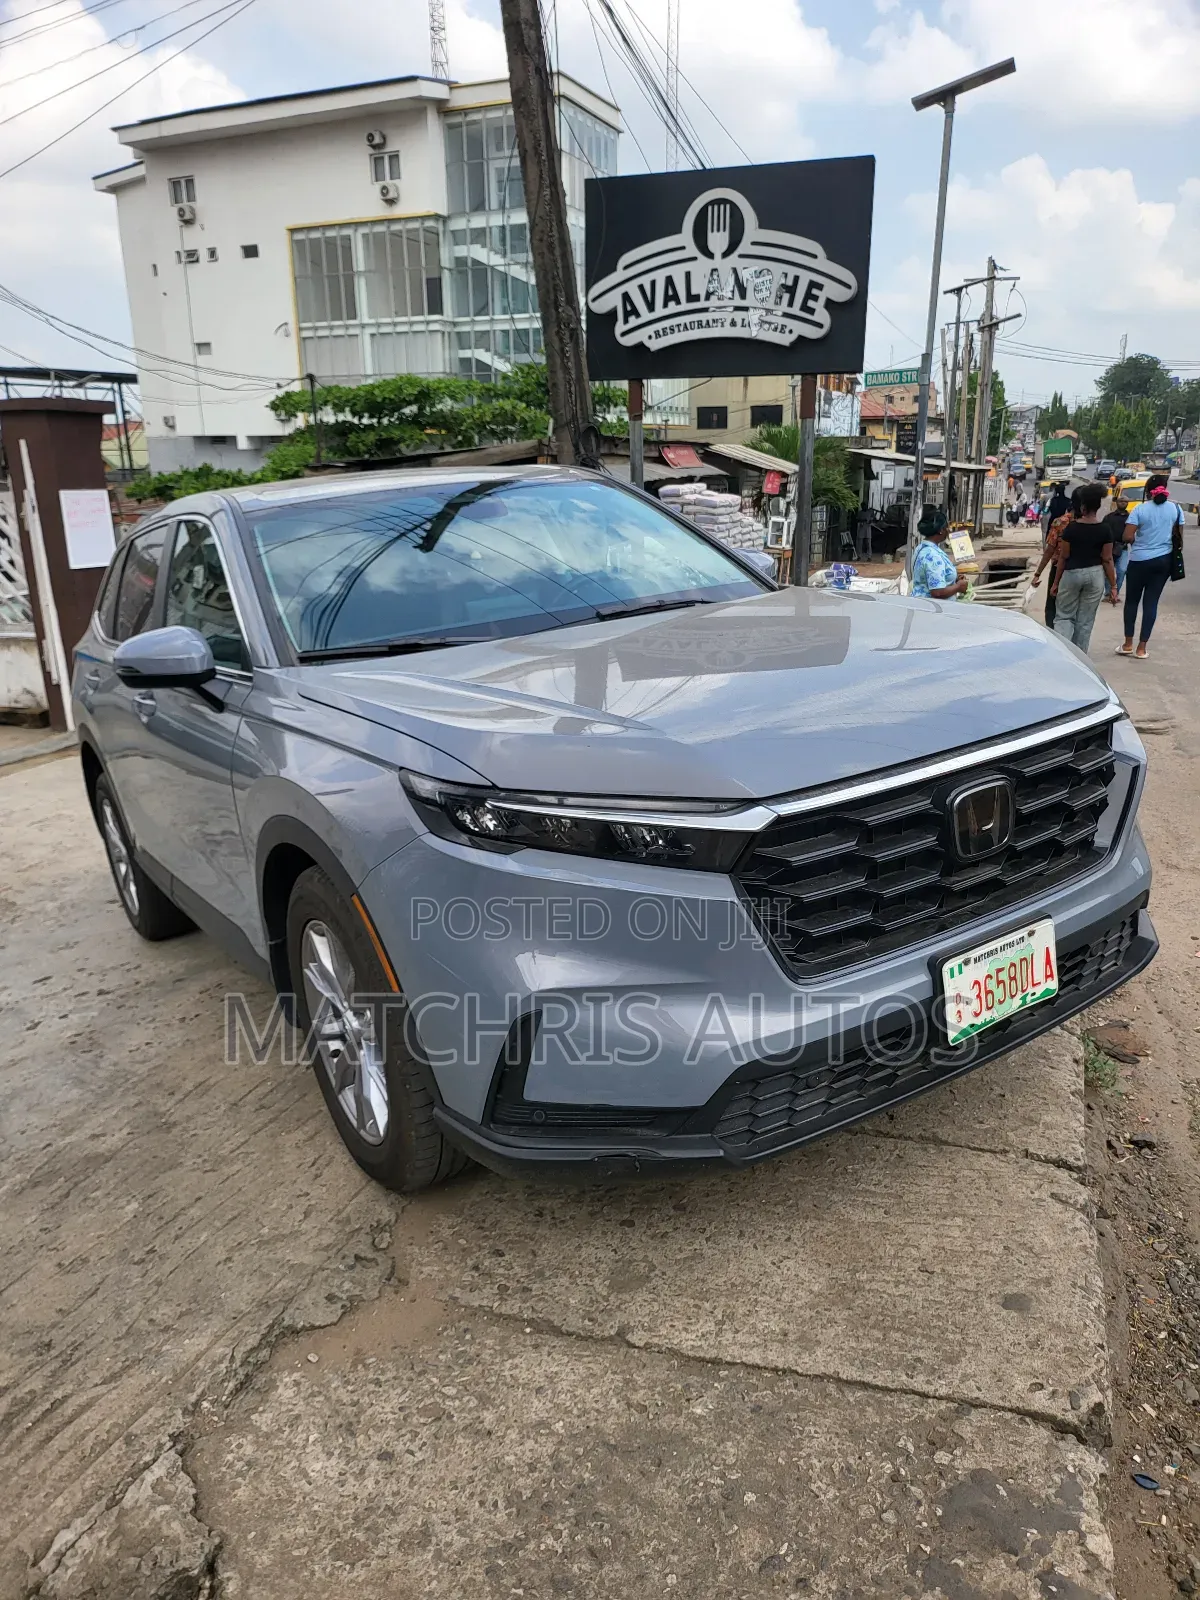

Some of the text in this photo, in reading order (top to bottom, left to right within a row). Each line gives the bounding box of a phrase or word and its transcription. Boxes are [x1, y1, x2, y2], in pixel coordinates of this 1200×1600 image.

[729, 317, 738, 328] &
[866, 371, 918, 386] BAMAKO STR
[973, 946, 999, 964] MATCHRIS
[999, 940, 1015, 953] AUTOS
[970, 946, 1055, 1018] 3658DLA
